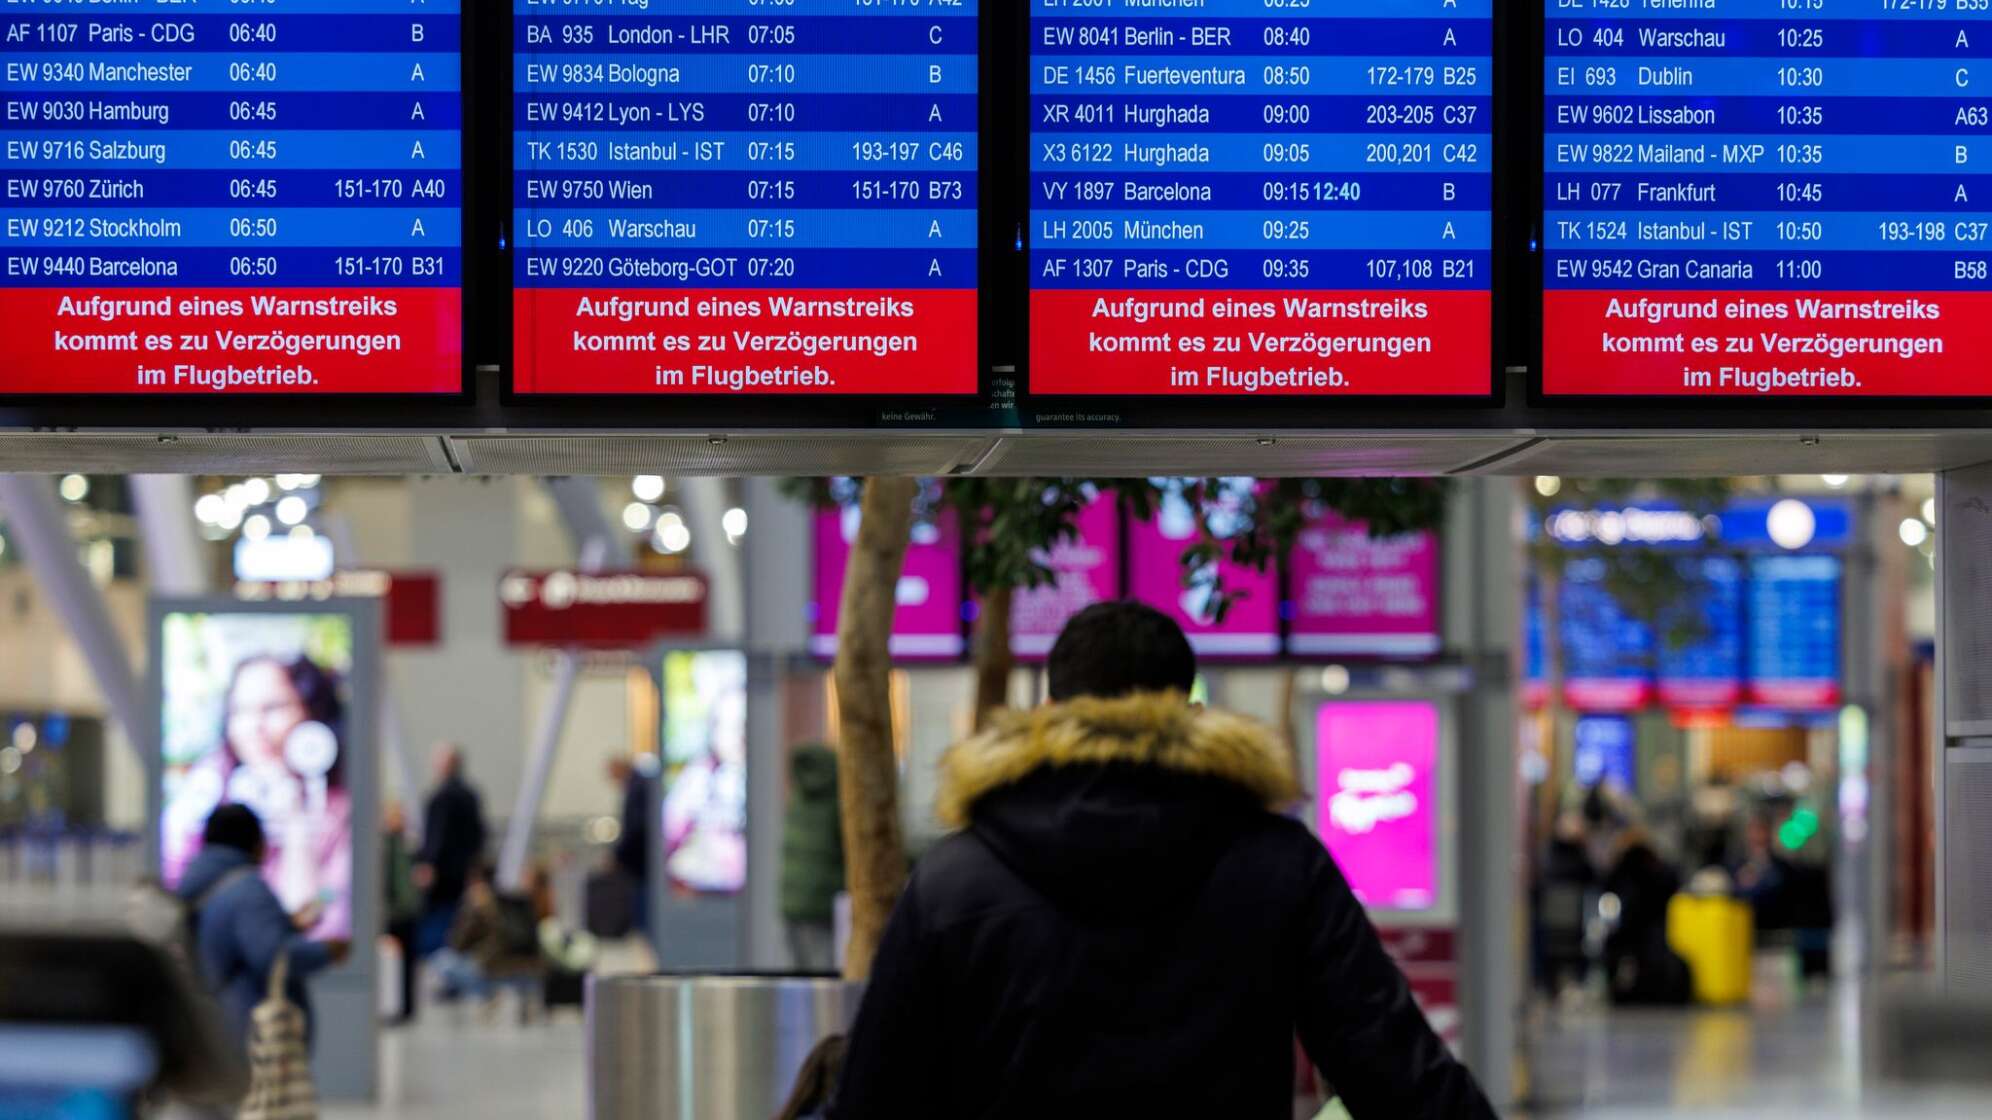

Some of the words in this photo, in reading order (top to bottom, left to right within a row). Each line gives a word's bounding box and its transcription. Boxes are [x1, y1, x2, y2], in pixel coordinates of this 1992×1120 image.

[1558, 27, 1583, 47] LO
[1592, 27, 1624, 47] 404
[1638, 27, 1726, 48] Warschau
[1777, 28, 1823, 48] 10:25
[1955, 29, 1969, 48] A
[7, 62, 39, 82] EW
[42, 62, 85, 82] 9340
[89, 61, 193, 82] Manchester
[229, 62, 277, 82] 06:40
[410, 63, 425, 81] A
[527, 63, 558, 83] EW
[562, 63, 604, 83] 9834
[608, 63, 680, 87] Bologna
[748, 63, 795, 84] 07:10
[929, 64, 942, 84] B
[1043, 65, 1069, 85] DE
[1075, 65, 1116, 85] 1456
[1124, 65, 1246, 85] Fuerteventura
[1263, 65, 1310, 86] 08:50
[1367, 65, 1435, 86] 172-179
[1443, 66, 1477, 86] B25
[1558, 66, 1575, 86] EI
[1585, 66, 1617, 86] 693
[1638, 66, 1693, 86] Dublin
[1777, 67, 1823, 87] 10:30
[1955, 67, 1969, 88] C
[7, 101, 39, 120] EW
[42, 100, 85, 121] 9030
[89, 100, 169, 125] Hamburg
[229, 100, 277, 121] 06:45
[411, 101, 425, 120] A
[1043, 104, 1070, 123] XR
[1074, 103, 1113, 123] 4011
[1124, 103, 1210, 128] Hurghada
[1263, 104, 1310, 124] 09:00
[1366, 104, 1434, 124] 203-205
[1443, 105, 1477, 124] C37
[1557, 105, 1589, 124] EW
[1592, 104, 1634, 124] 9602
[1638, 105, 1715, 125] Lissabon
[1777, 105, 1823, 125] 10:35
[1954, 106, 1988, 126] A63
[7, 140, 39, 160] EW
[42, 140, 85, 160] 9716
[89, 139, 166, 164] Salzburg
[229, 139, 277, 160] 06:45
[411, 140, 425, 159] A
[1043, 143, 1066, 162] X3
[1071, 143, 1113, 162] 6122
[1124, 143, 1209, 167] Hurghada
[1263, 143, 1310, 162] 09:05
[1366, 143, 1431, 165] 200,201
[1442, 143, 1477, 163] C42
[7, 179, 39, 198] EW
[42, 178, 85, 199] 9760
[88, 179, 144, 199] Zürich
[229, 178, 277, 198] 06:45
[335, 178, 403, 198] 151-170
[411, 178, 446, 198] A40
[527, 179, 558, 199] EW
[562, 179, 604, 199] 9750
[608, 180, 653, 200] Wien
[748, 180, 795, 200] 07:15
[852, 180, 920, 200] 151-170
[929, 180, 962, 200] B73
[1042, 181, 1068, 200] VY
[1074, 181, 1115, 201] 1897
[1124, 181, 1211, 201] Barcelona
[1263, 181, 1310, 201] 09:15
[1313, 181, 1361, 201] 12:40
[1443, 182, 1456, 201] B
[1557, 182, 1580, 201] LH
[1590, 182, 1622, 201] 077
[1638, 182, 1716, 202] Frankfurt
[1776, 182, 1822, 202] 10:45
[1954, 183, 1968, 202] A
[7, 218, 39, 238] EW
[42, 218, 85, 238] 9212
[89, 217, 181, 238] Stockholm
[229, 217, 277, 237] 06:50
[411, 218, 425, 237] A
[527, 218, 552, 238] LO
[562, 218, 593, 238] 406
[608, 218, 696, 239] Warschau
[748, 218, 795, 238] 07:15
[928, 219, 942, 238] A
[1043, 220, 1066, 239] LH
[1072, 220, 1113, 240] 2005
[1124, 220, 1204, 240] München
[1263, 220, 1310, 240] 09:25
[1442, 221, 1456, 240] A
[7, 256, 39, 276] EW
[43, 256, 85, 276] 9440
[89, 256, 178, 276] Barcelona
[230, 256, 277, 276] 06:50
[335, 256, 403, 276] 151-170
[412, 256, 443, 276] B31
[527, 257, 558, 276] EW
[562, 257, 604, 277] 9220
[608, 257, 738, 281] Göteborg-GOT
[748, 257, 795, 277] 07:20
[928, 258, 942, 277] A
[1557, 259, 1588, 278] EW
[1591, 259, 1633, 278] 9542
[1637, 259, 1680, 279] Gran
[1685, 259, 1753, 279] Canaria
[1776, 259, 1822, 279] 11:00
[1954, 260, 1988, 280] B58
[57, 295, 172, 322] Aufgrund
[178, 295, 244, 317] eines
[250, 295, 398, 317] Warnstreiks
[575, 295, 690, 322] Aufgrund
[696, 296, 762, 317] eines
[767, 296, 914, 318] Warnstreiks
[1091, 297, 1205, 323] Aufgrund
[1211, 297, 1276, 318] eines
[1282, 297, 1428, 319] Warnstreiks
[1605, 297, 1718, 324] Aufgrund
[1724, 298, 1789, 319] eines
[1795, 298, 1940, 320] Warnstreiks
[54, 330, 139, 351] kommt
[144, 334, 173, 351] es
[179, 334, 208, 351] zu
[215, 330, 401, 356] Verzögerungen
[573, 330, 657, 351] kommt
[662, 335, 691, 352] es
[697, 335, 726, 352] zu
[732, 330, 917, 357] Verzögerungen
[1089, 331, 1172, 353] kommt
[1178, 336, 1206, 353] es
[1212, 336, 1241, 353] zu
[1247, 331, 1431, 358] Verzögerungen
[1602, 332, 1685, 353] kommt
[1690, 336, 1719, 353] es
[1725, 337, 1754, 353] zu
[1760, 332, 1943, 359] Verzögerungen
[137, 364, 166, 385] im
[174, 364, 319, 390] Flugbetrieb.
[655, 365, 684, 385] im
[691, 365, 836, 391] Flugbetrieb.
[1171, 366, 1199, 386] im
[1207, 366, 1350, 392] Flugbetrieb.
[1683, 366, 1712, 387] im
[1719, 366, 1862, 393] Flugbetrieb.
[881, 411, 902, 421] keine
[1035, 413, 1074, 423] guarantee
[1075, 412, 1085, 421] its
